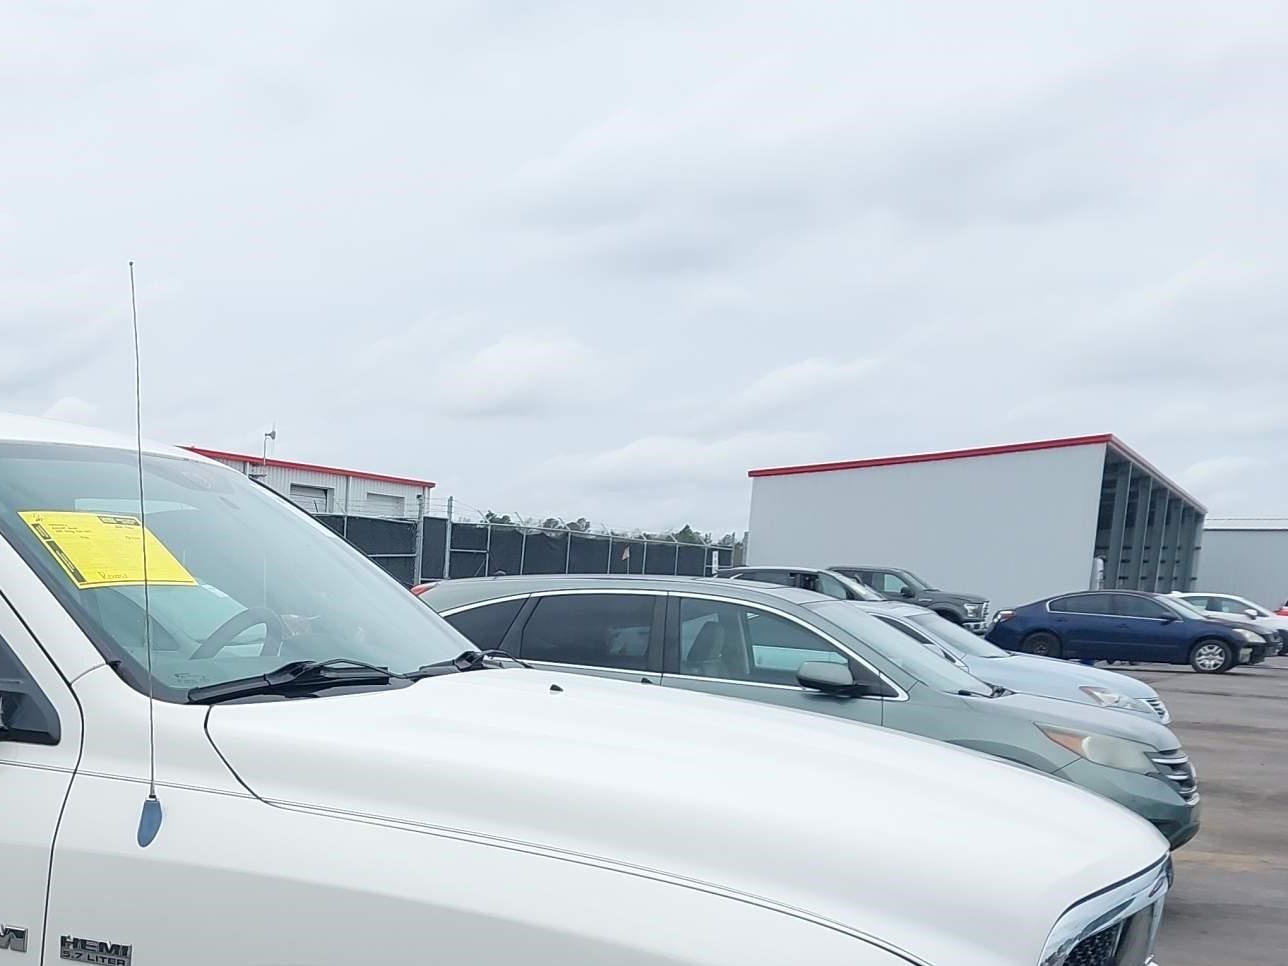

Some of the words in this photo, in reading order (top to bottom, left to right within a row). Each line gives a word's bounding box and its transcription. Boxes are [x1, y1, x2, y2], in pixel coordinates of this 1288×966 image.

[60, 935, 131, 956] HEMI
[62, 950, 83, 960] 5.7
[87, 953, 126, 966] LITER
